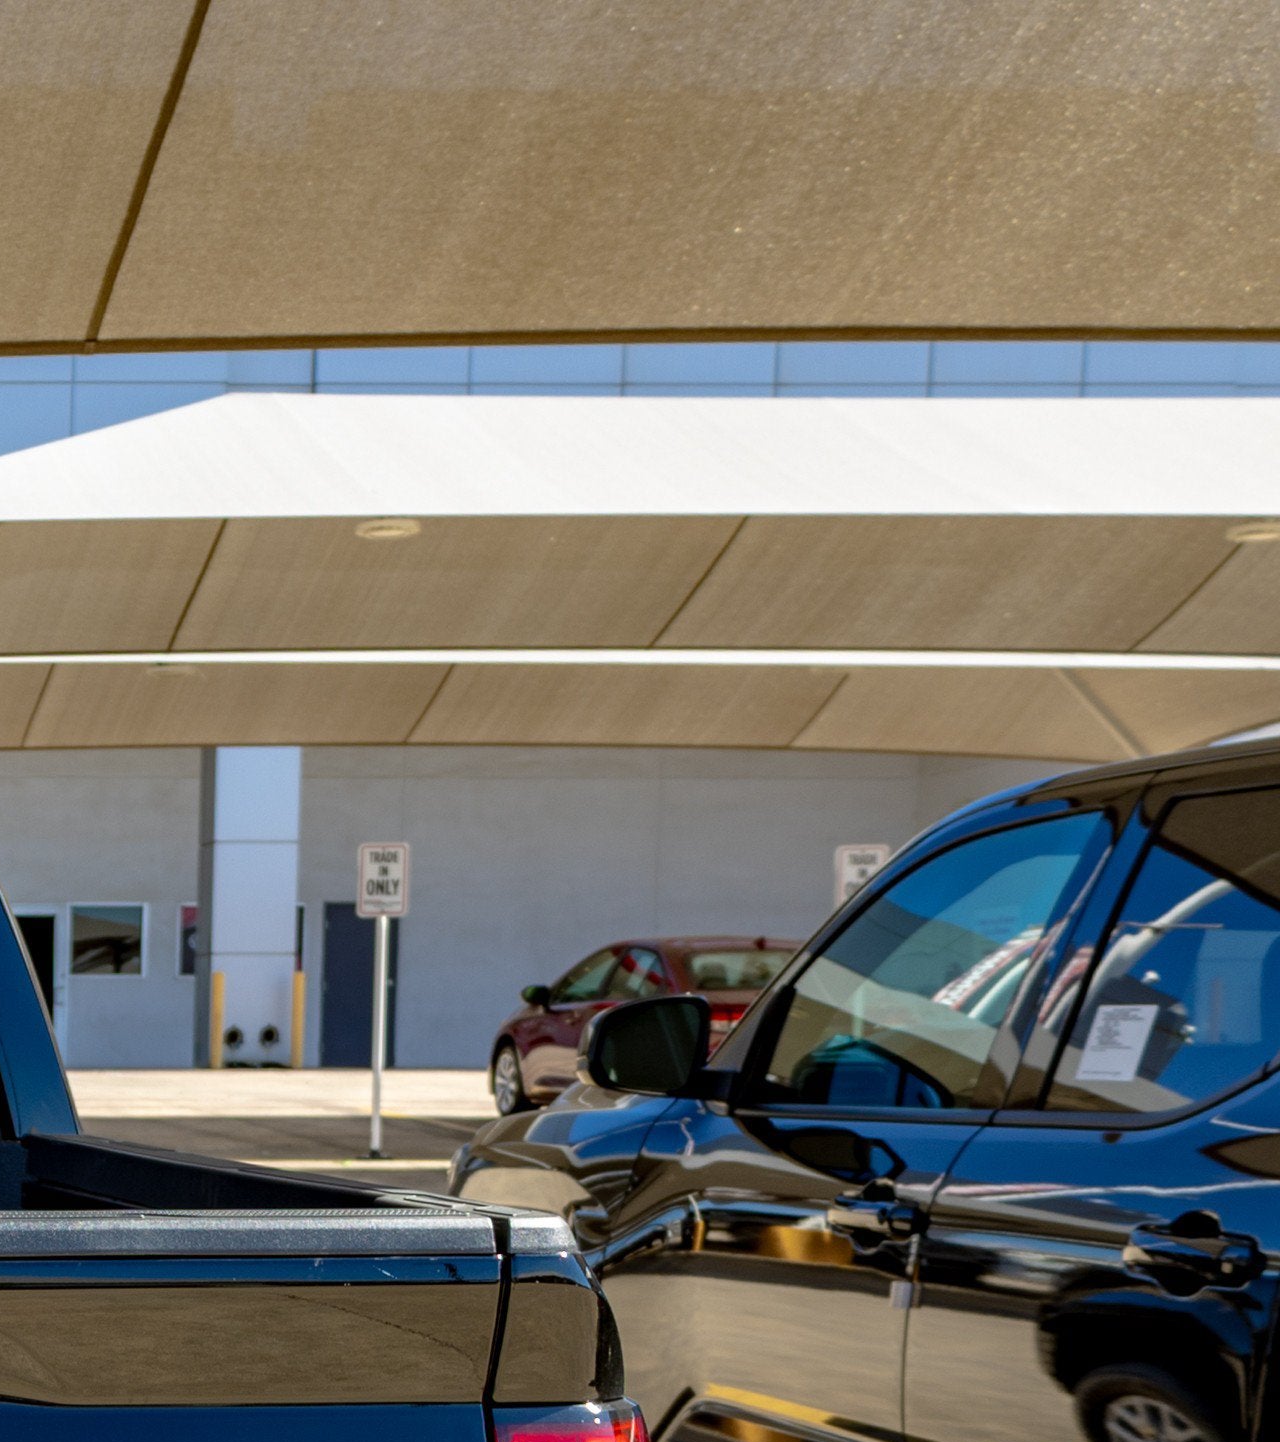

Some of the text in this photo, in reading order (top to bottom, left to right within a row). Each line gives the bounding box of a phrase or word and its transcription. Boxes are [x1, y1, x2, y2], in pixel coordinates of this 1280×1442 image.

[369, 851, 399, 863] TRADE
[379, 866, 389, 877] IN
[366, 880, 400, 896] ONLY
